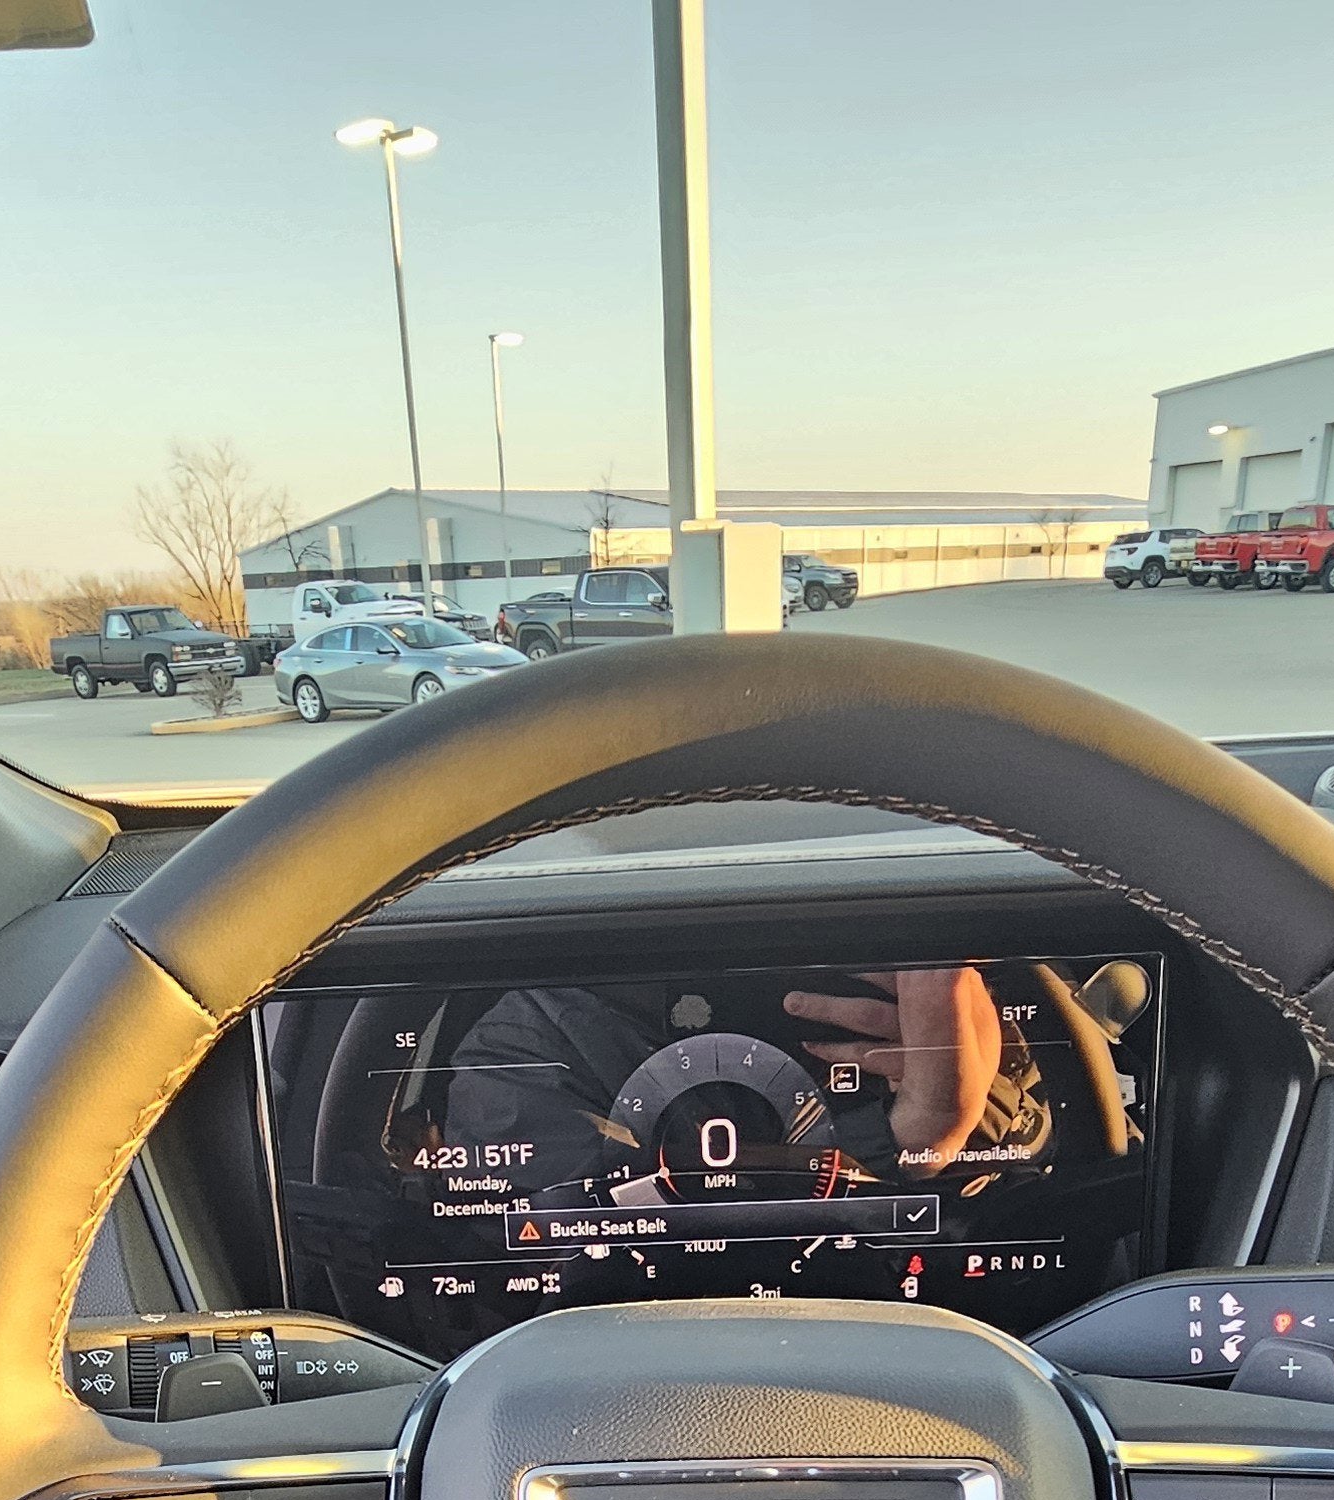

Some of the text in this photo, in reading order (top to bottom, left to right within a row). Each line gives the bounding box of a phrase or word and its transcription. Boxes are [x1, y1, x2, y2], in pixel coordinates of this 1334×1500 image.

[1002, 1005, 1038, 1022] 51°F
[395, 1031, 417, 1048] SE
[680, 1057, 691, 1070] 3
[743, 1054, 753, 1067] 4
[632, 1099, 643, 1112] 2
[795, 1091, 805, 1105] 5
[700, 1118, 737, 1168] 0
[413, 1143, 534, 1170] 4:23 51°F
[898, 1144, 1032, 1165] Audio Unavailable
[809, 1157, 819, 1171] 6
[448, 1175, 513, 1193] Monday,
[583, 1178, 594, 1193] F
[704, 1174, 737, 1189] MPH
[433, 1198, 531, 1218] December 15
[549, 1217, 667, 1238] Buckle Seat Belt
[684, 1239, 727, 1253] x1000
[790, 1259, 802, 1274] C
[967, 1254, 1066, 1272] P R N D L
[646, 1265, 656, 1280] E
[431, 1276, 476, 1295] 73mi
[506, 1277, 540, 1292] AWD
[1188, 1295, 1202, 1312] R
[1189, 1320, 1203, 1338] N
[169, 1351, 189, 1364] OFF
[254, 1349, 275, 1361] OFF
[1190, 1347, 1204, 1365] D
[257, 1364, 275, 1376] INT
[259, 1380, 275, 1391] ON
